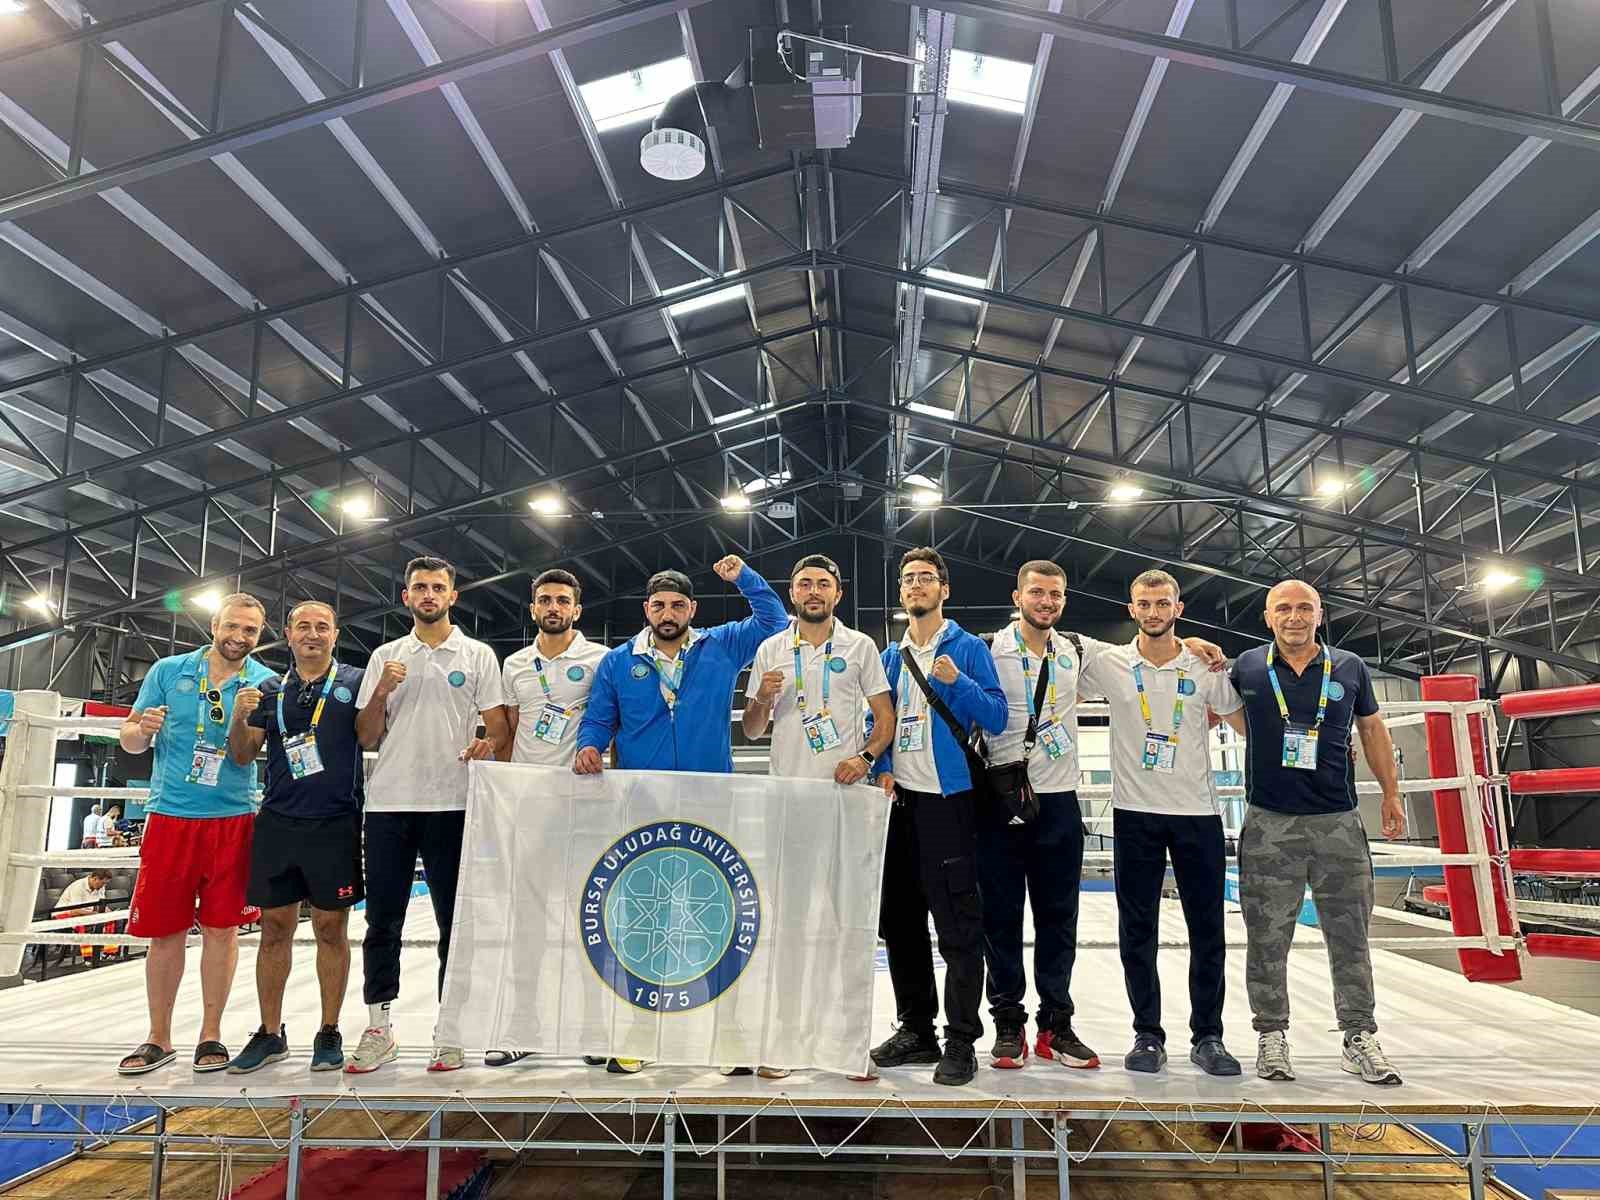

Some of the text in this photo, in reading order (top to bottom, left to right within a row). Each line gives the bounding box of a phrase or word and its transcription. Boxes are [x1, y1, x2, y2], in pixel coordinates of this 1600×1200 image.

[585, 823, 759, 955] BURSA ULUDAĞ ÜNİVERSİTESİ
[634, 987, 690, 1008] 1975
